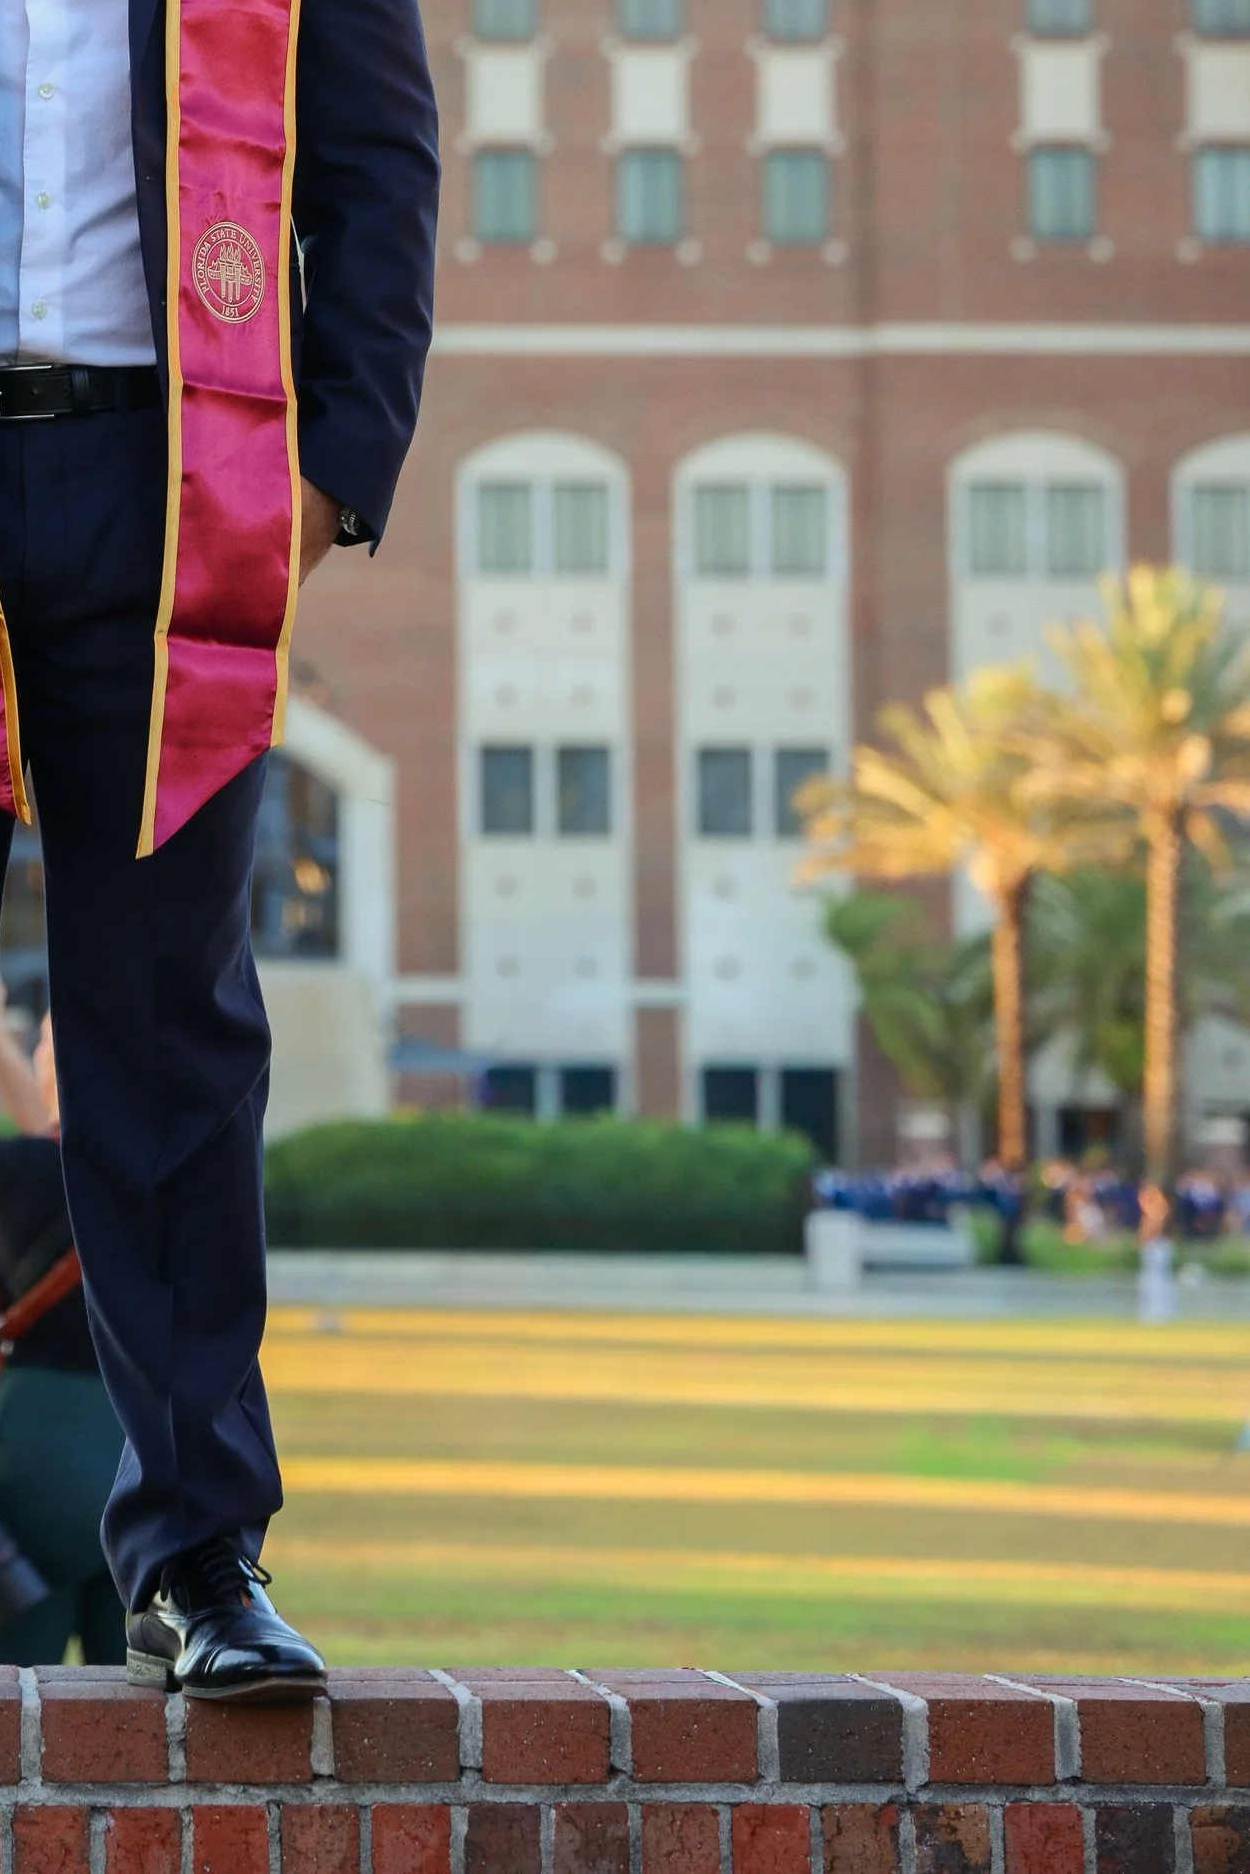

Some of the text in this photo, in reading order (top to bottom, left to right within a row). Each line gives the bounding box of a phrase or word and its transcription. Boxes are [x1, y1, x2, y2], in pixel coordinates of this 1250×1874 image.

[197, 228, 261, 303] FLORIDA STATE UNIVERSITY
[221, 305, 240, 317] 1851
